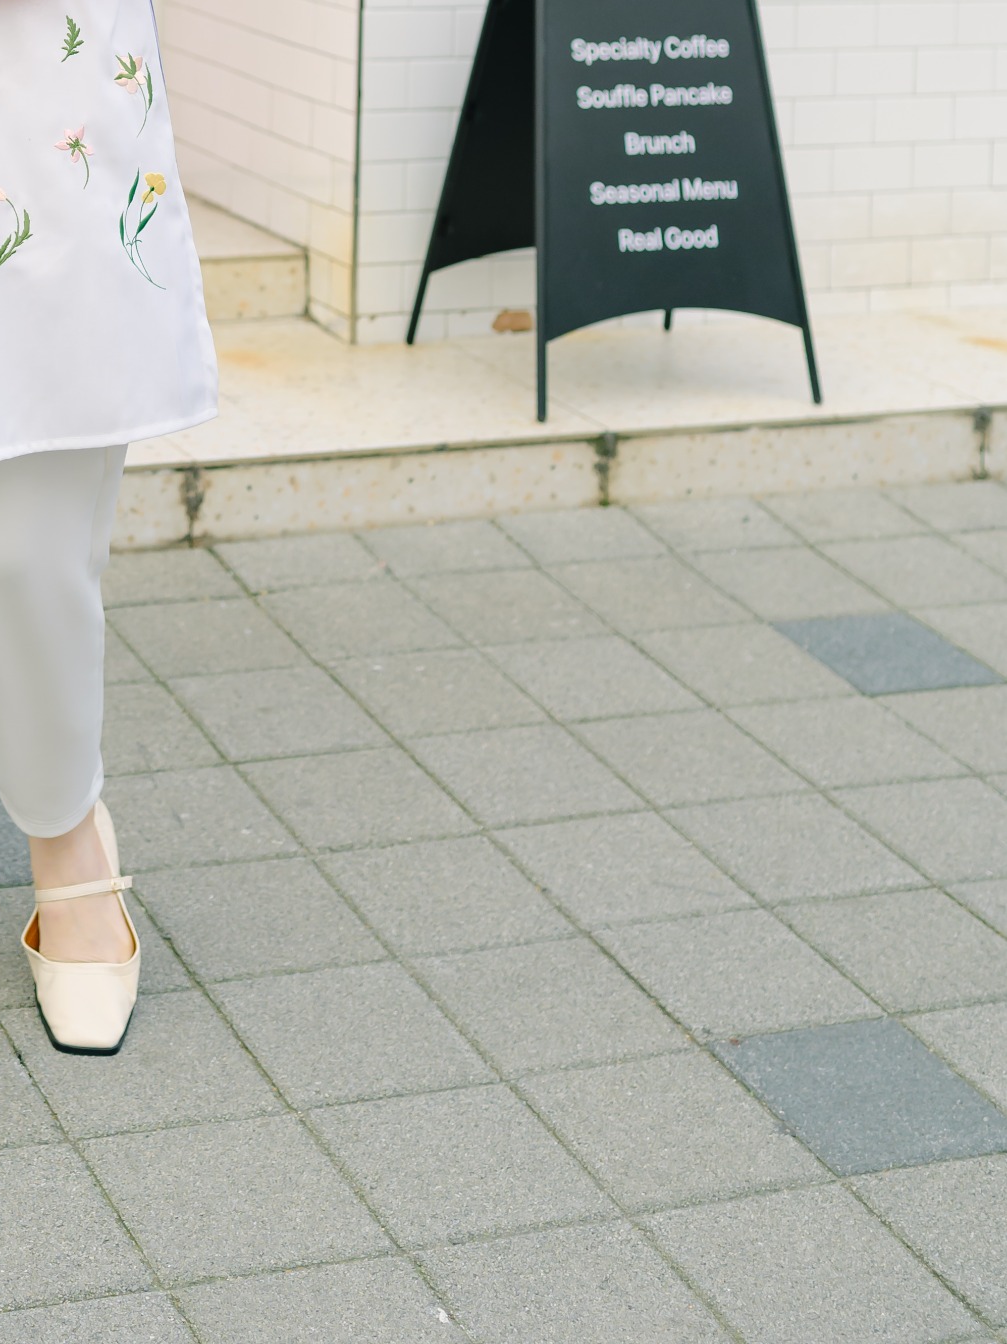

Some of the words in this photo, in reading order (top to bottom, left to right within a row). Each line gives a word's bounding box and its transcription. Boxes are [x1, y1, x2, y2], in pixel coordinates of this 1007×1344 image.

[570, 36, 662, 66] Specialty
[663, 34, 730, 59] Coffee
[576, 83, 649, 109] Souffle
[649, 81, 733, 106] Pancake
[623, 130, 696, 156] Brunch
[589, 178, 681, 206] Seasonal
[681, 177, 739, 201] Menu
[617, 227, 664, 253] Real
[664, 224, 719, 251] Good
